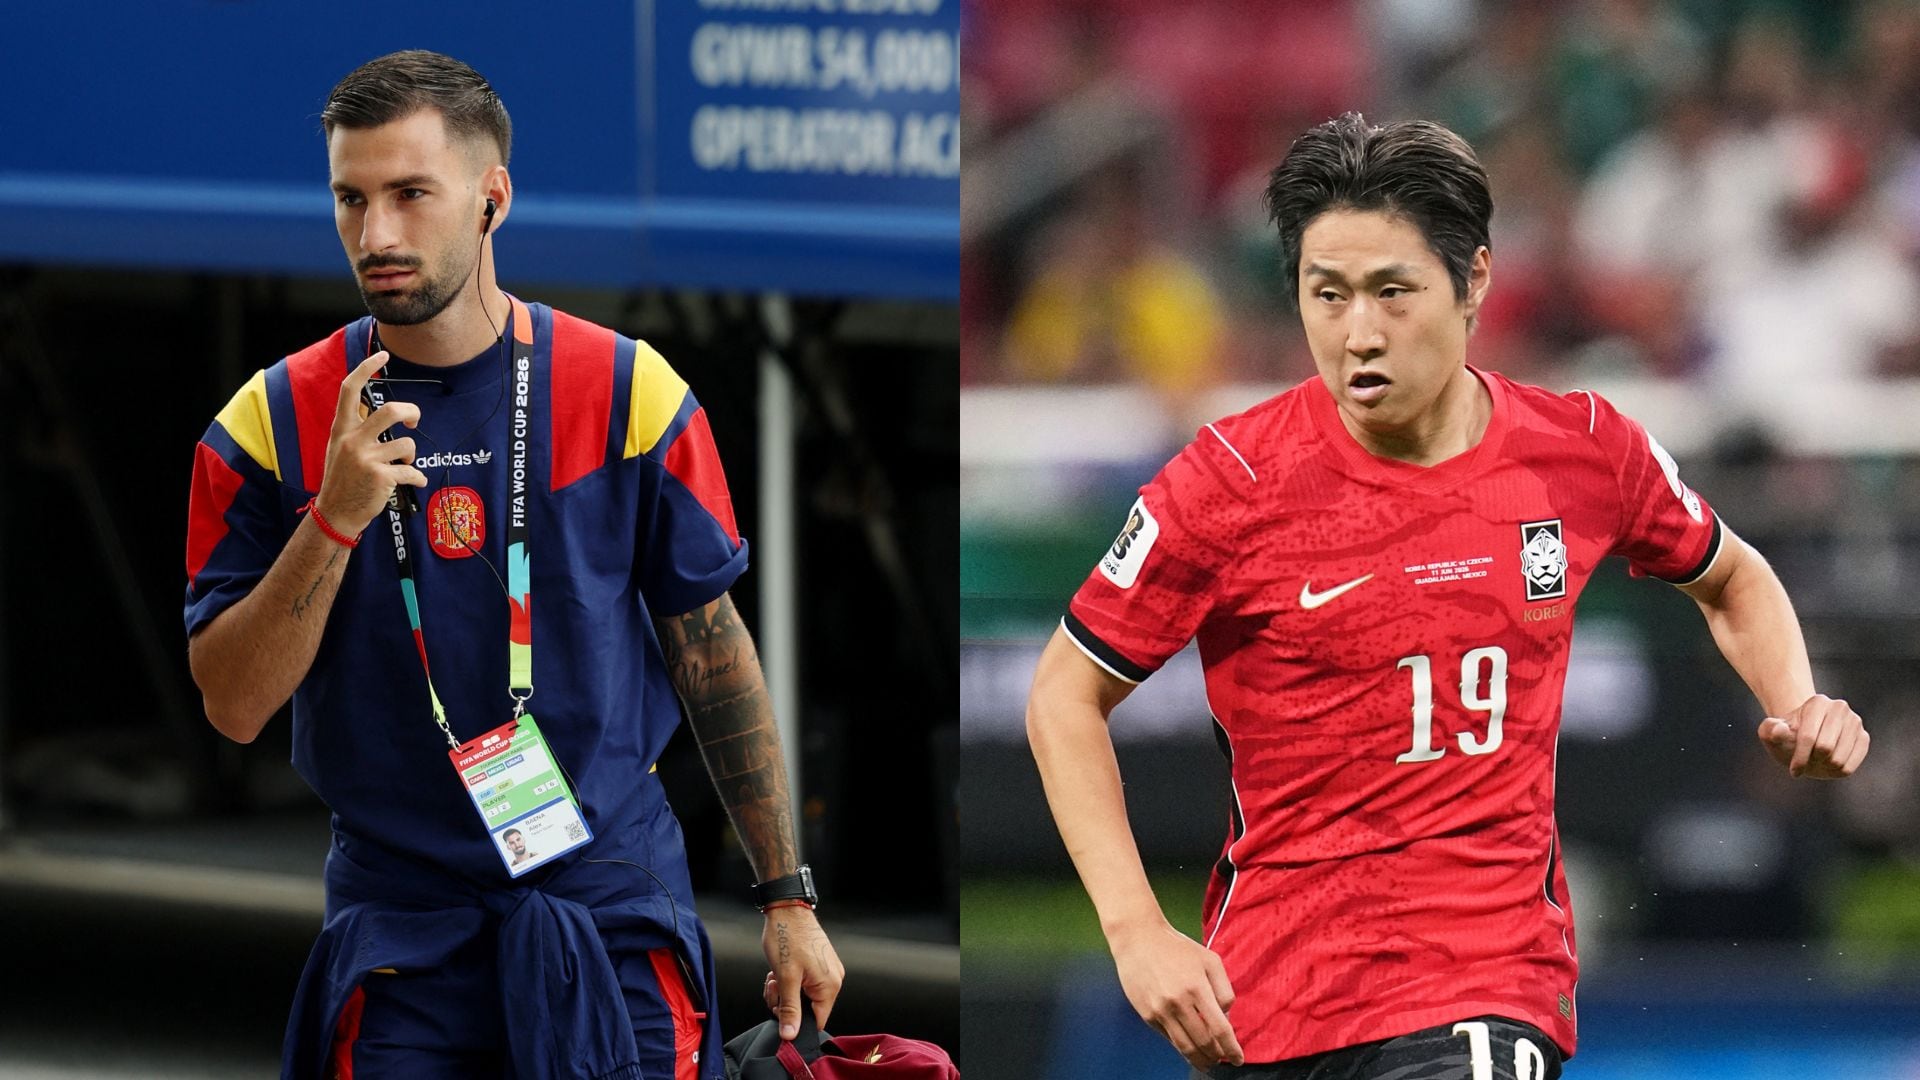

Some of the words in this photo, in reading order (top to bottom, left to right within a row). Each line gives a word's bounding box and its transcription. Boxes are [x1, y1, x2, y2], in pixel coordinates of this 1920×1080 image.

[691, 104, 895, 175] OPERATOR
[516, 358, 530, 407] 2026
[514, 409, 527, 438] CUP
[416, 452, 472, 468] adidas
[513, 440, 526, 494] WORLD
[513, 495, 525, 528] FIFA
[390, 510, 406, 561] 2026
[1427, 561, 1458, 570] REPUBLIC
[1523, 602, 1566, 622] KOREA
[1395, 646, 1508, 765] 19
[459, 756, 474, 767] FIFA
[472, 745, 497, 761] WORLD
[495, 739, 509, 750] CUP
[481, 793, 507, 809] PLAYER
